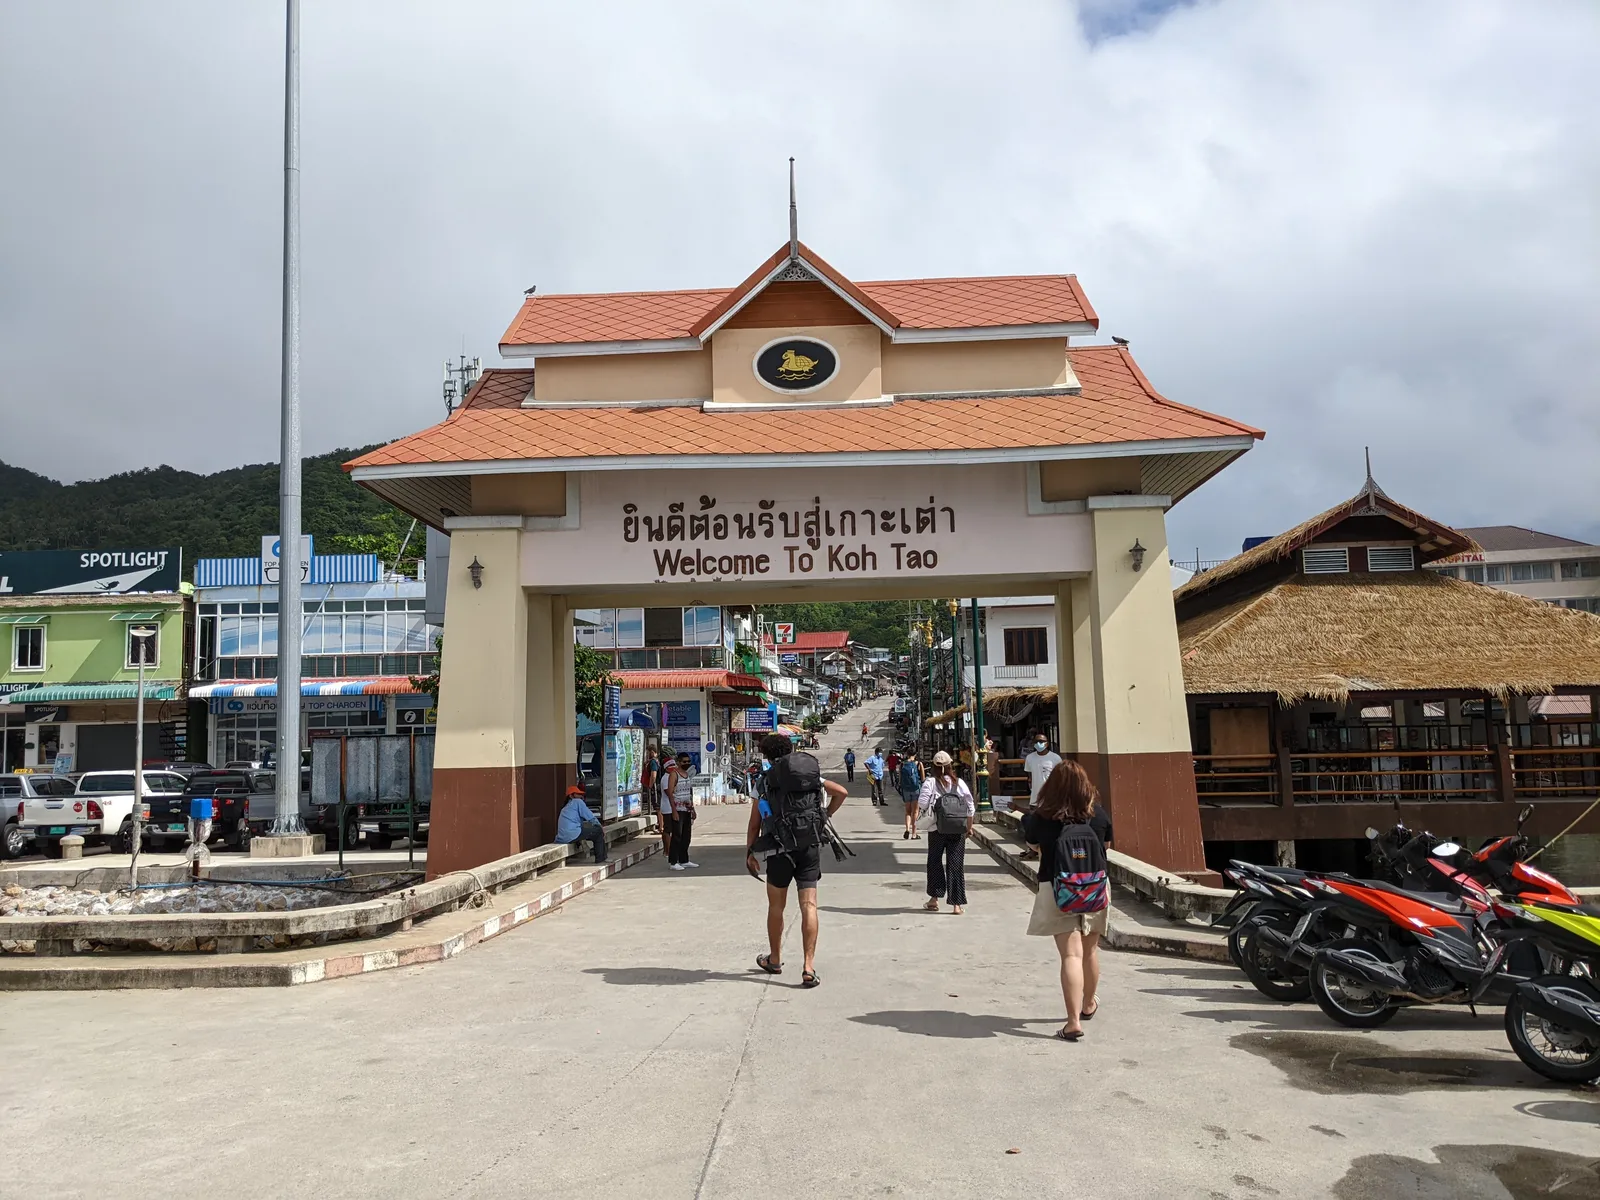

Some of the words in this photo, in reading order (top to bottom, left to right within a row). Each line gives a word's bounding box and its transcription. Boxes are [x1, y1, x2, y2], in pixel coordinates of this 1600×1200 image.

[623, 495, 955, 550] ยินดีต้อนรับสู่เกาะเต่า
[80, 551, 168, 568] SPOTLIGHT
[653, 548, 770, 576] Welcome
[784, 545, 813, 573] To
[828, 543, 877, 572] Koh
[891, 543, 938, 569] Tao
[308, 702, 325, 710] TOP
[327, 701, 367, 709] CHAROEN
